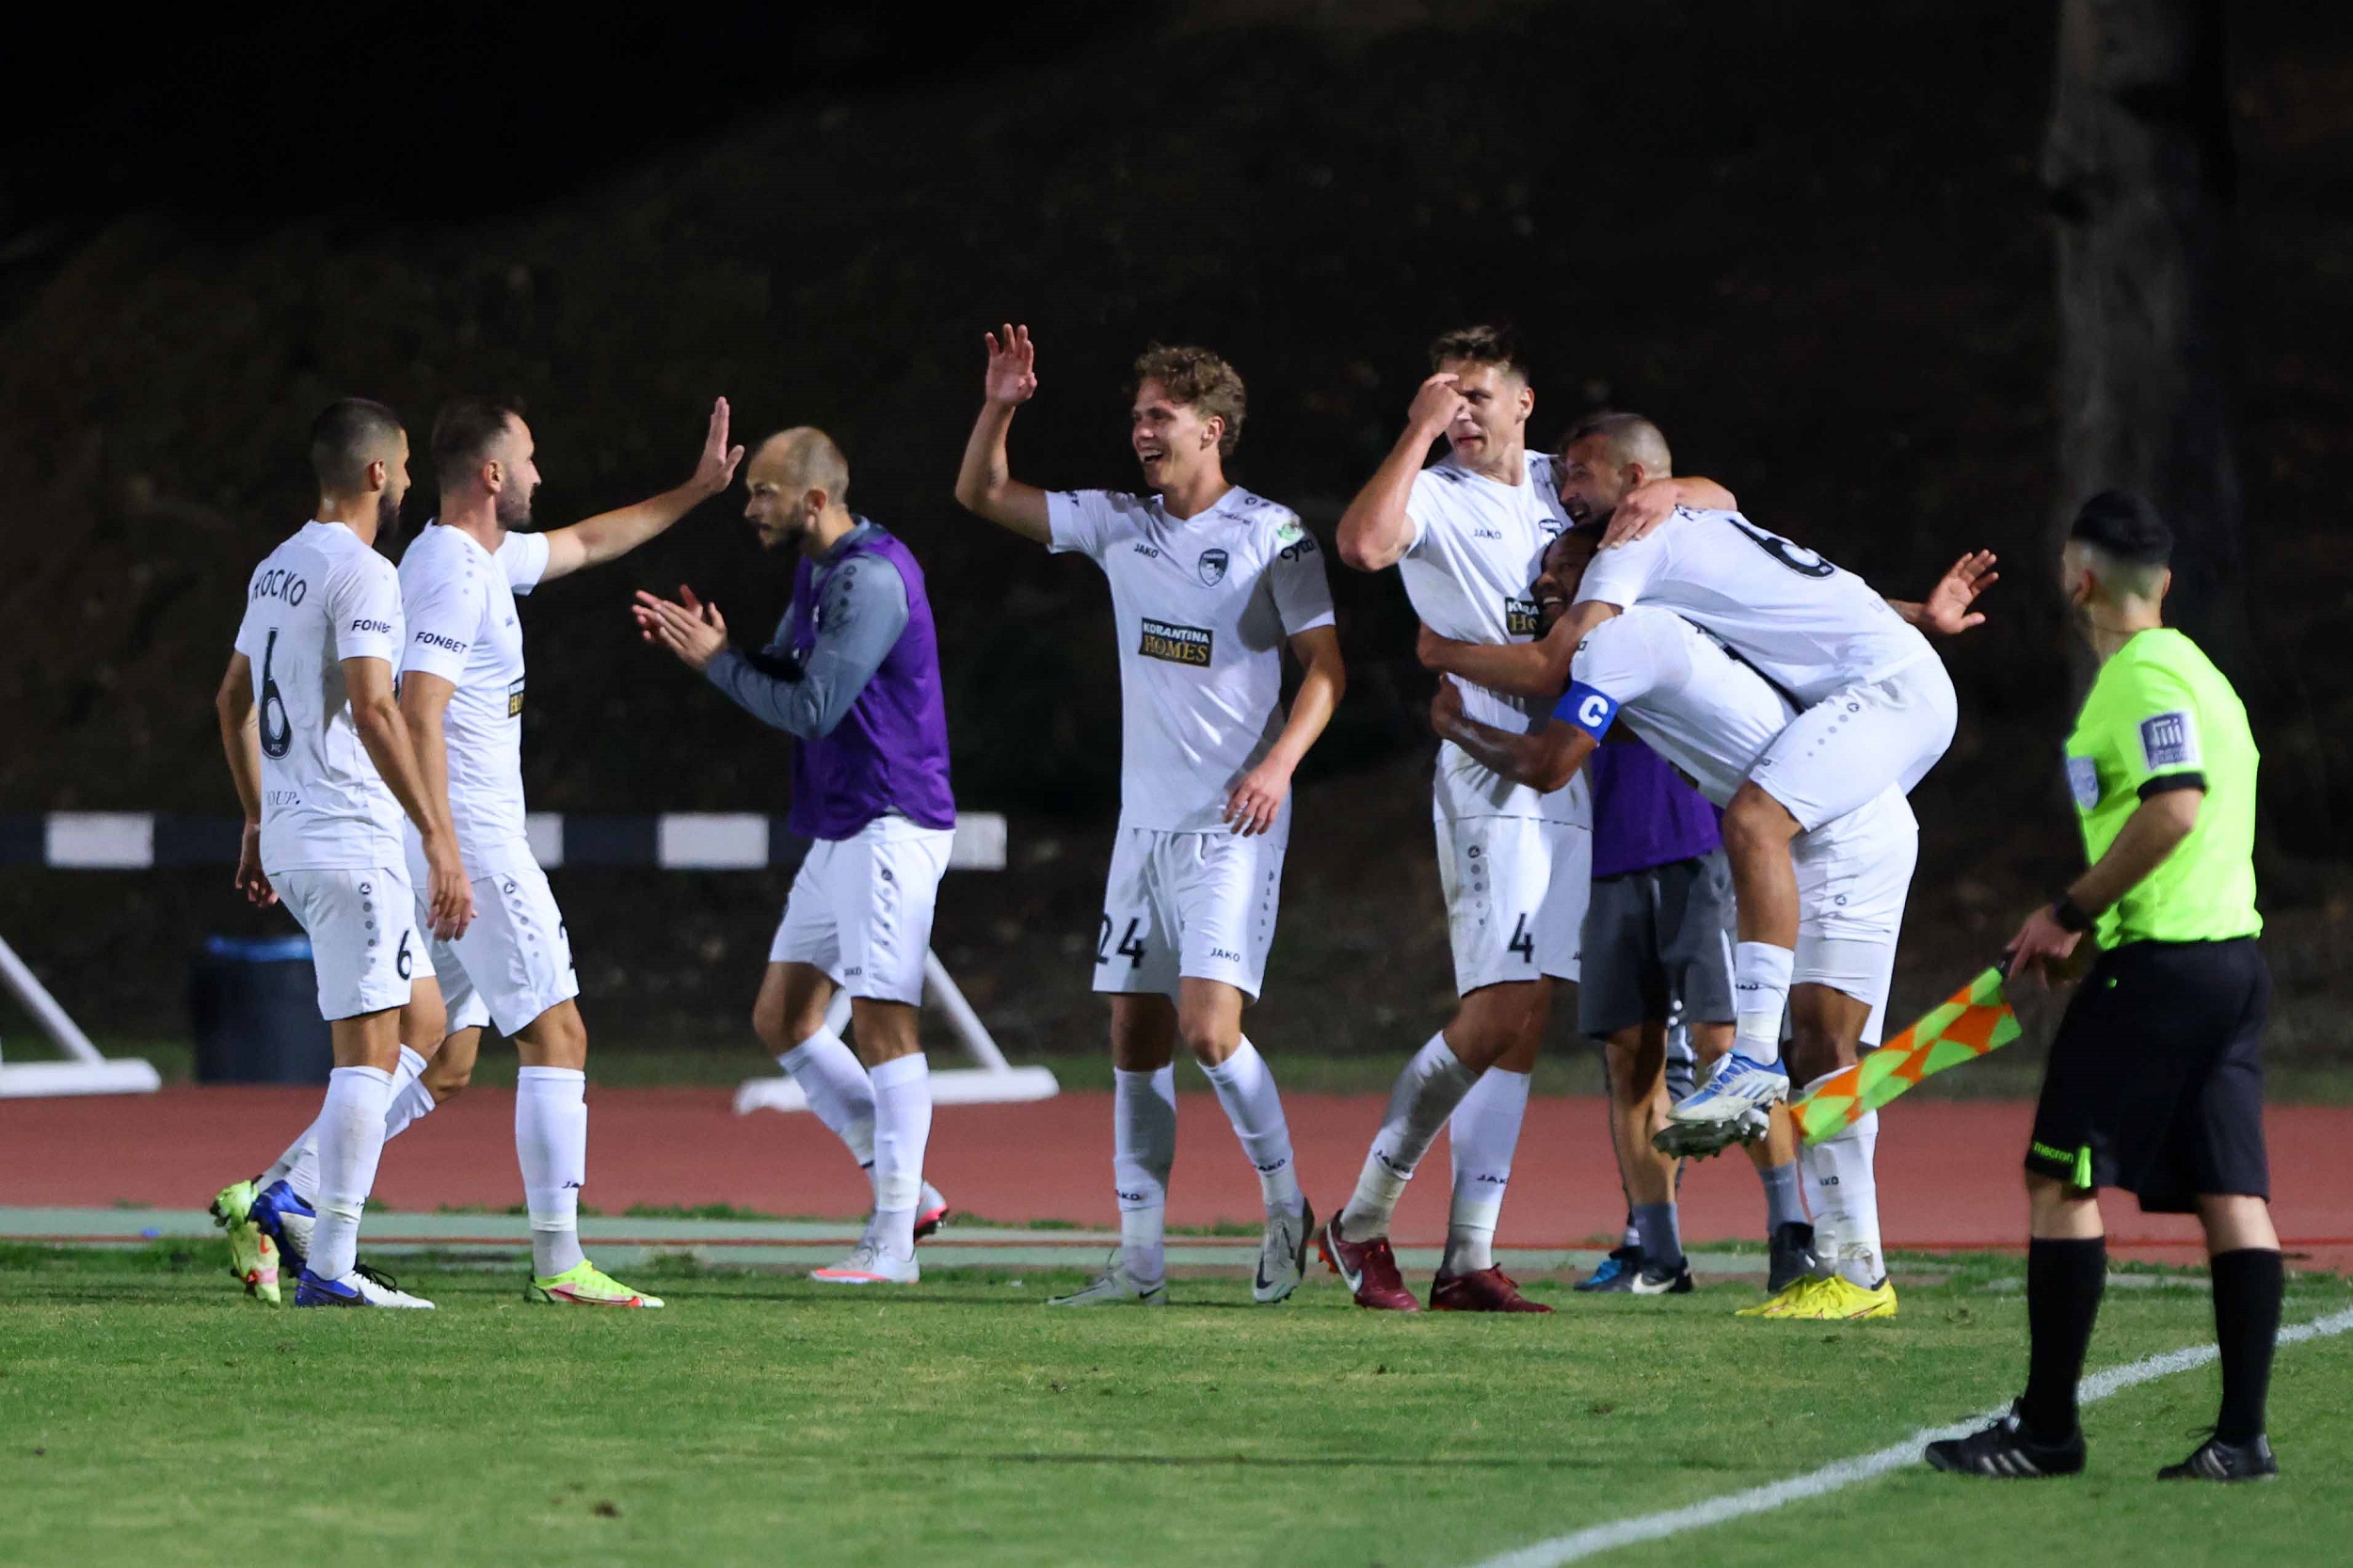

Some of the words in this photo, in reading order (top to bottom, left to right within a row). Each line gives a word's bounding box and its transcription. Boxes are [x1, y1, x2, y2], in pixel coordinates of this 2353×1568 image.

[1474, 528, 1502, 540] JAKO
[1134, 543, 1159, 559] JAKO
[415, 632, 469, 654] FONBET
[1143, 621, 1210, 645] KORANTINA
[1144, 635, 1209, 664] HOMES
[259, 626, 294, 760] 6
[1578, 695, 1609, 728] C
[1096, 914, 1144, 968] 24
[1508, 913, 1534, 964] 4
[396, 929, 412, 981] 6
[1210, 947, 1241, 963] JAKO
[2034, 1141, 2074, 1163] macron
